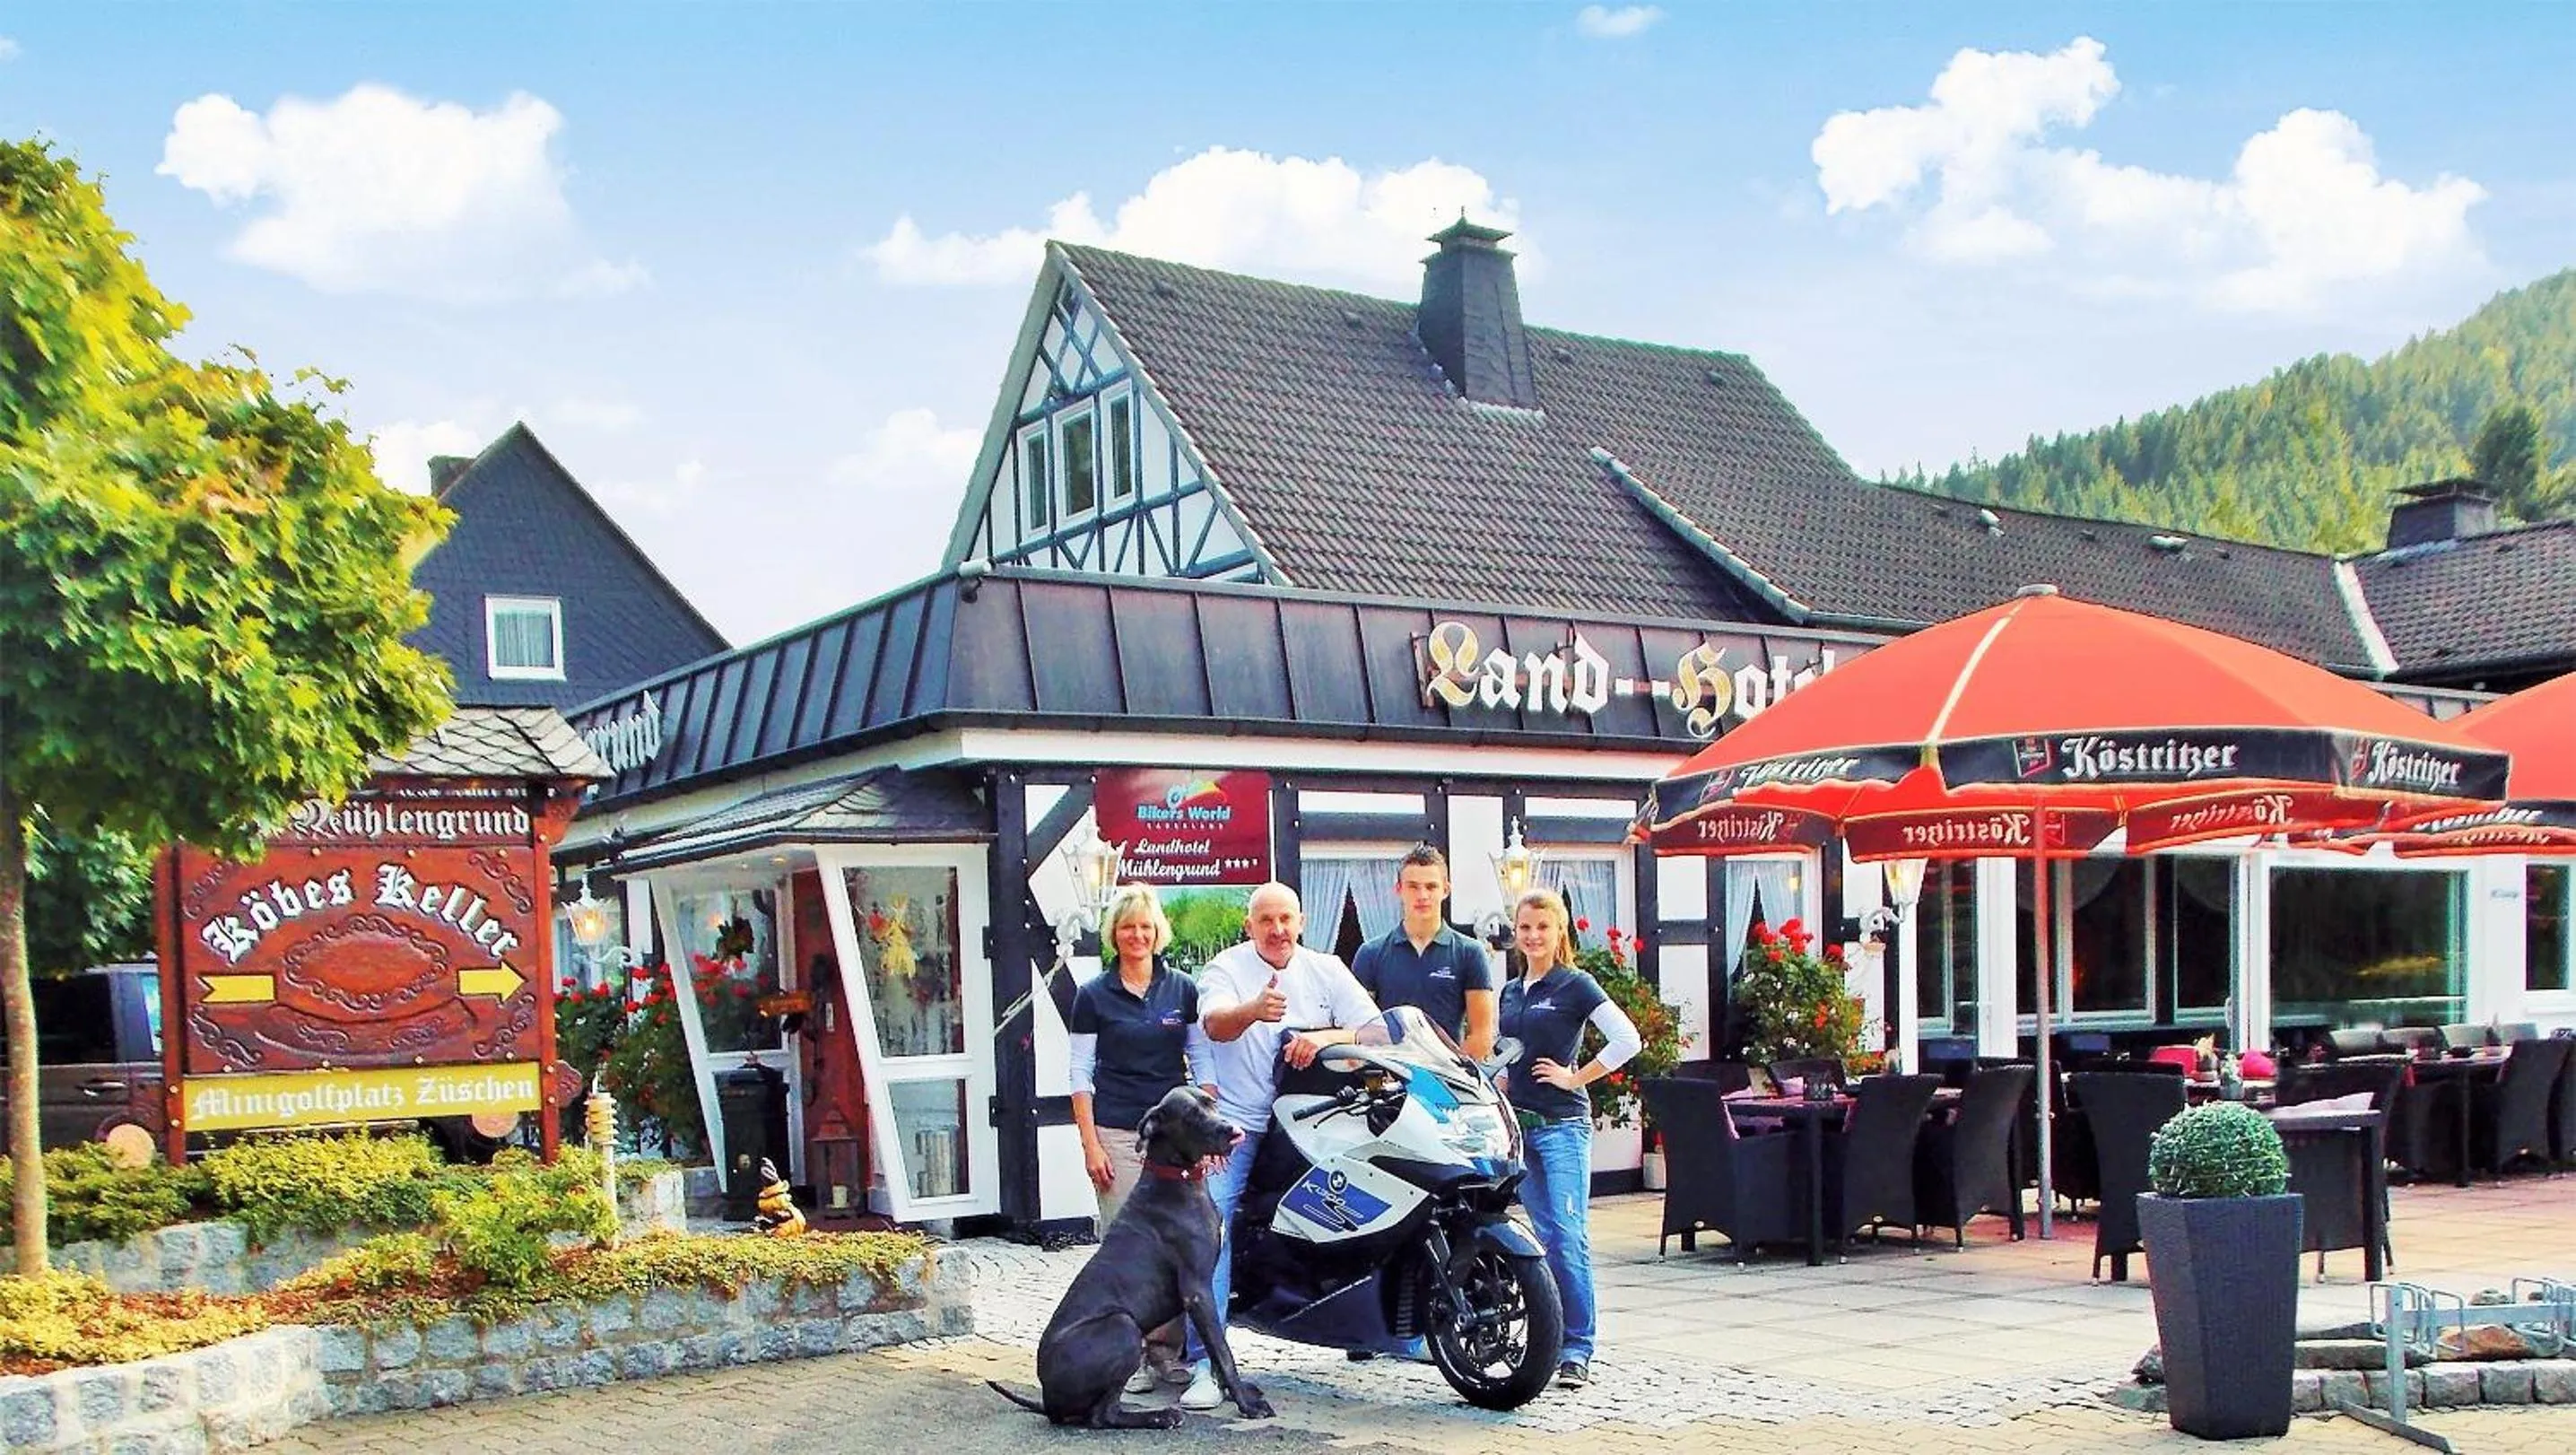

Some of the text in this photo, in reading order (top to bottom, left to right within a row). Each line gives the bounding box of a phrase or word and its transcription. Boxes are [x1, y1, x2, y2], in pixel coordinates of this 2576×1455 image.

[2060, 736, 2239, 780] Köstritzer
[2368, 741, 2461, 791] Köstritzer
[1188, 805, 1231, 821] World
[1134, 838, 1210, 854] Landhotel
[1119, 858, 1221, 882] Mühlengrund
[201, 864, 518, 963] Köbes Keller
[191, 1076, 535, 1120] Minigolfplatz Züschen
